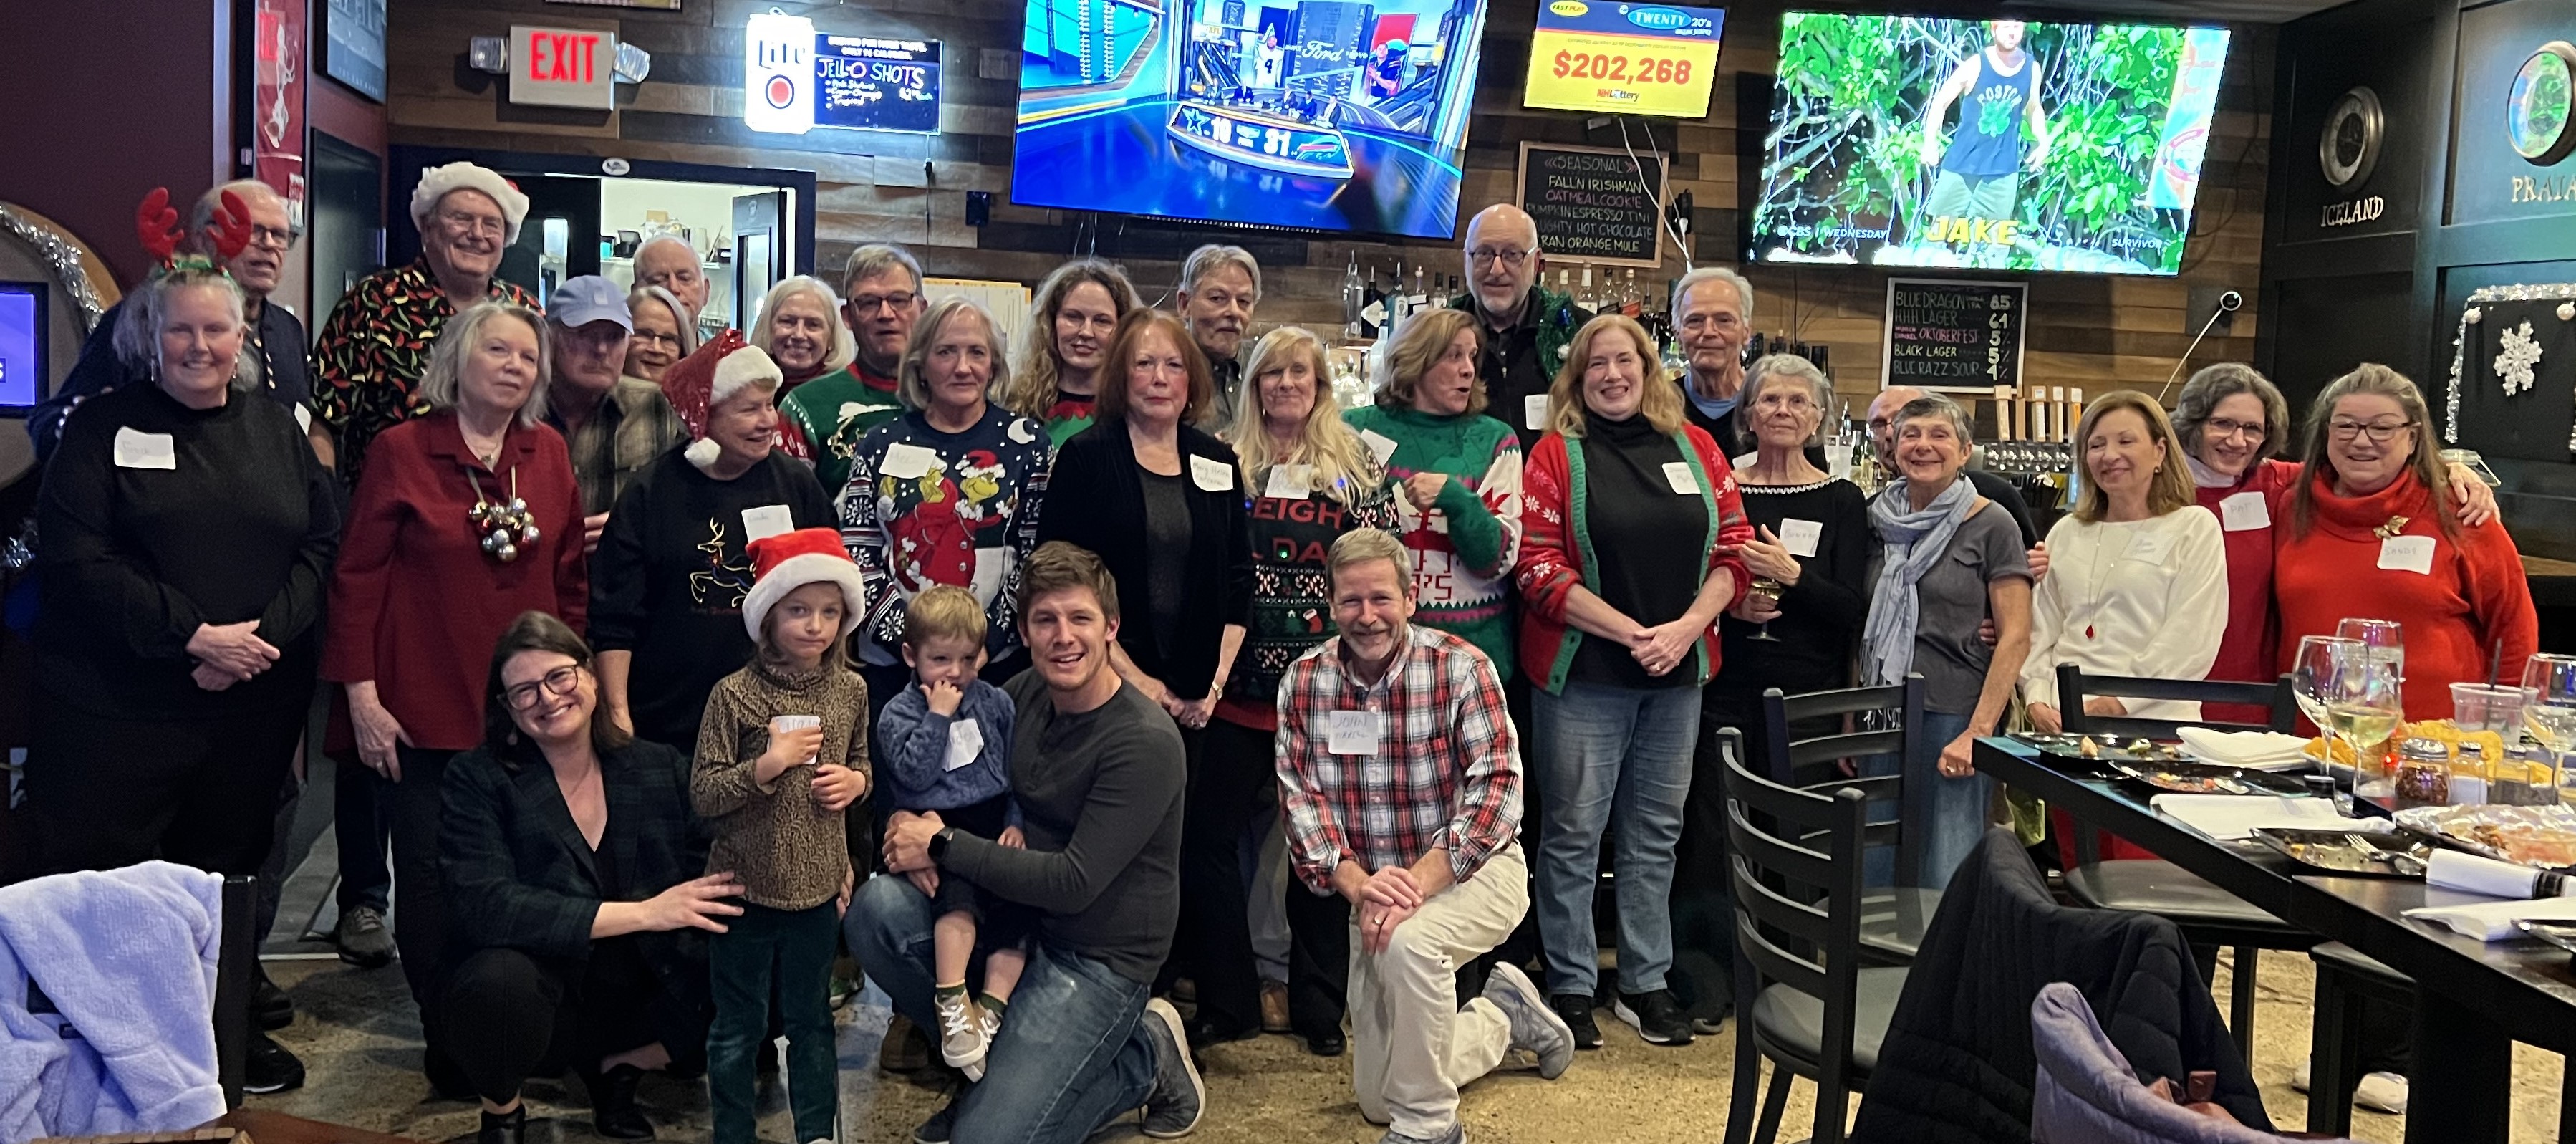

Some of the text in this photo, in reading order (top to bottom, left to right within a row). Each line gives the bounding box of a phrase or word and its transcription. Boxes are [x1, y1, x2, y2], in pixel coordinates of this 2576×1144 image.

[1636, 12, 1684, 26] TWENTY
[530, 32, 599, 84] EXIT
[1302, 40, 1346, 62] Ford
[817, 59, 925, 90] JELL-O SHOTS
[1264, 58, 1273, 74] 4
[1553, 49, 1692, 85] $202,268
[1210, 116, 1232, 144] 10
[1264, 128, 1292, 157] 31
[1557, 155, 1624, 173] SEASONAL
[1588, 180, 1642, 193] IRISHMAN
[2511, 175, 2576, 203] PRAIA
[1545, 189, 1642, 209] OATMEAL COOKIE
[1526, 203, 1651, 223] PUMPKIN ESPRESSO TINI
[2321, 196, 2384, 227] ICELAND
[1576, 222, 1596, 236] HOT
[1598, 223, 1654, 241] CHOCOLATE
[1788, 225, 1888, 240] CBS WEDNESDAY
[1926, 214, 2020, 245] JAKE
[1539, 234, 1640, 252] RAN ORANGE MULE
[1896, 292, 1921, 308] BLUE
[1922, 292, 1965, 310] DRAGON
[1922, 309, 1959, 327] LAGER
[1919, 327, 1978, 344] OKTOBERFEST
[1894, 344, 1923, 357] BLACK
[1926, 346, 1957, 357] LAGER
[1894, 360, 1916, 375] BLUE
[1919, 362, 1949, 377] RAZZ
[1952, 362, 1979, 377] SOUR
[2229, 503, 2252, 514] PAT
[1272, 537, 1328, 566] DA
[1333, 715, 1367, 729] JOHN
